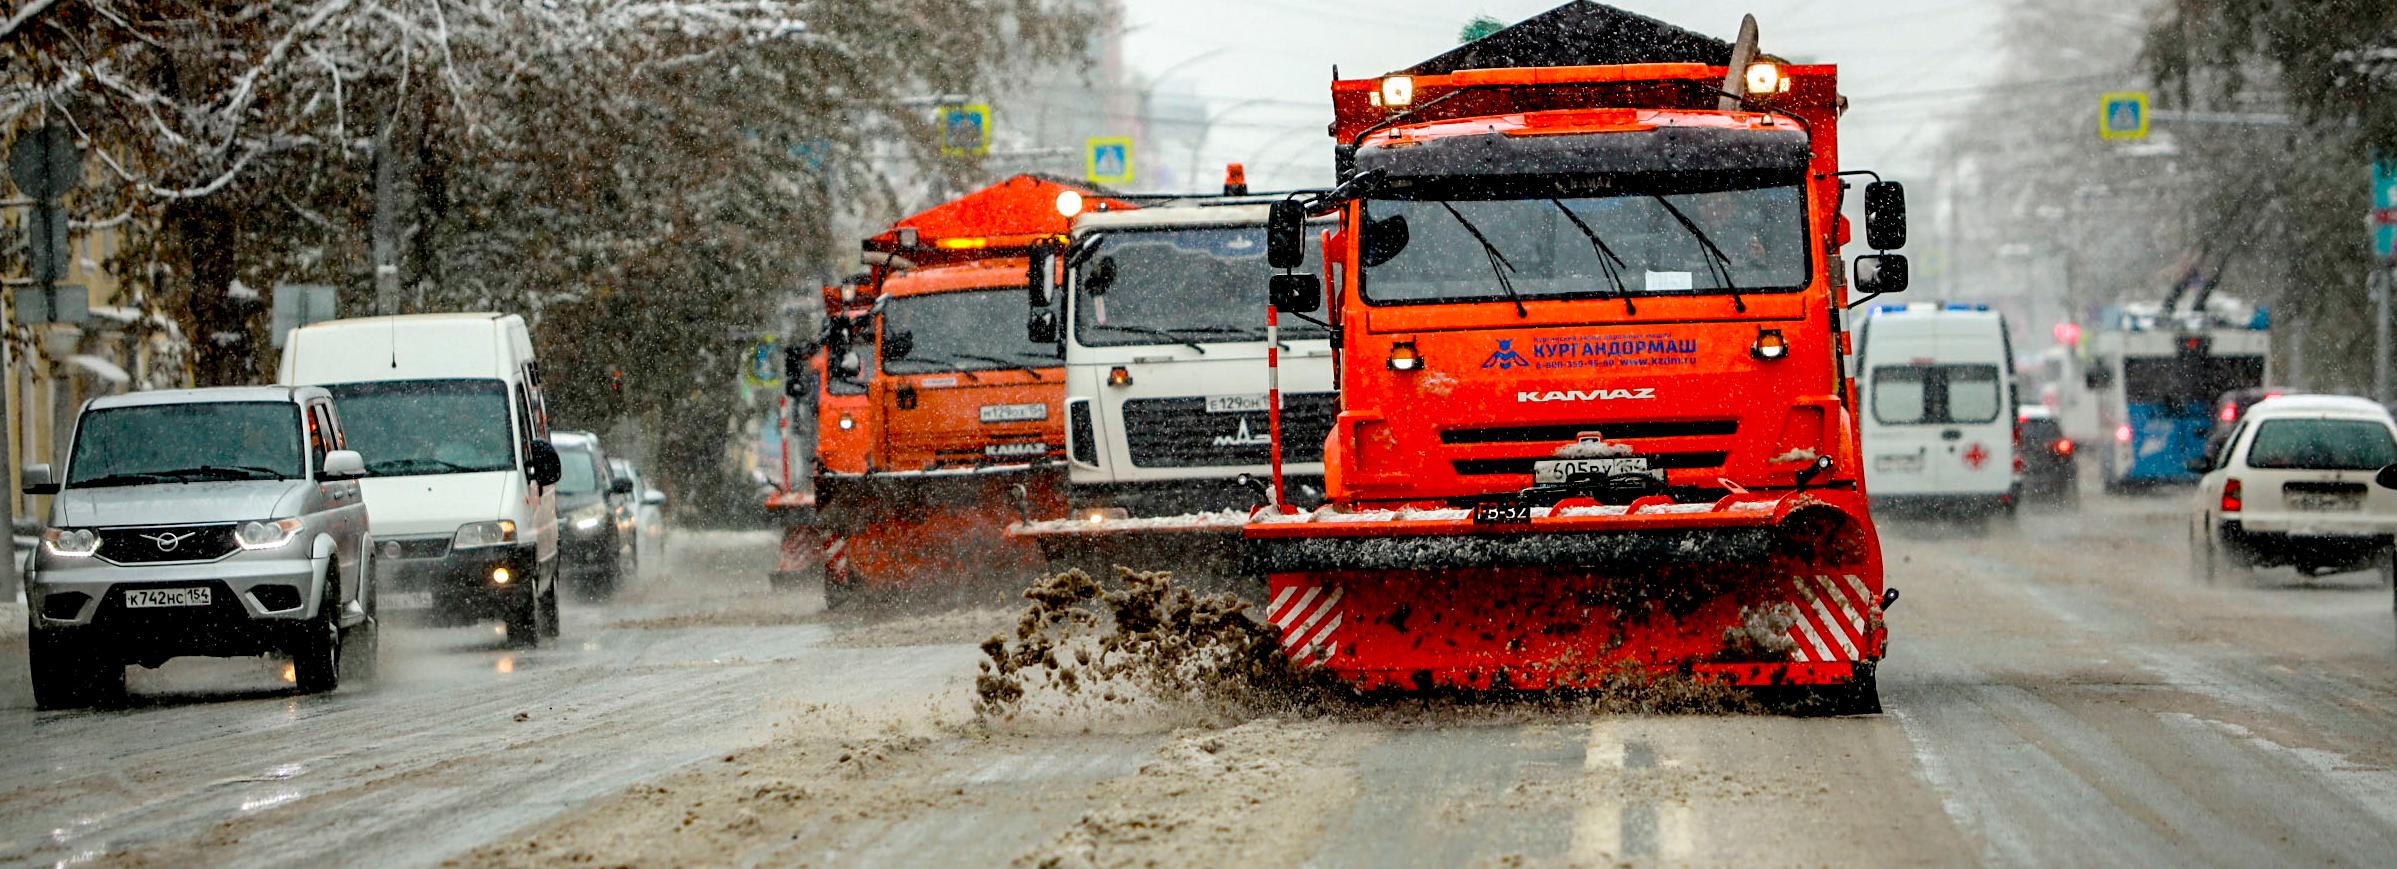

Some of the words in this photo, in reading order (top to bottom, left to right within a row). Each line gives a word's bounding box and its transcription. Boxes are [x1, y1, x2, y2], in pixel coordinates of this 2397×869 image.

[1533, 339, 1697, 358] КУРГАНДОРМАШ
[1620, 356, 1697, 367] www.kzdm.ru
[1517, 388, 1656, 403] KAMAZ
[130, 591, 184, 606] К742НС
[187, 588, 209, 601] 154
